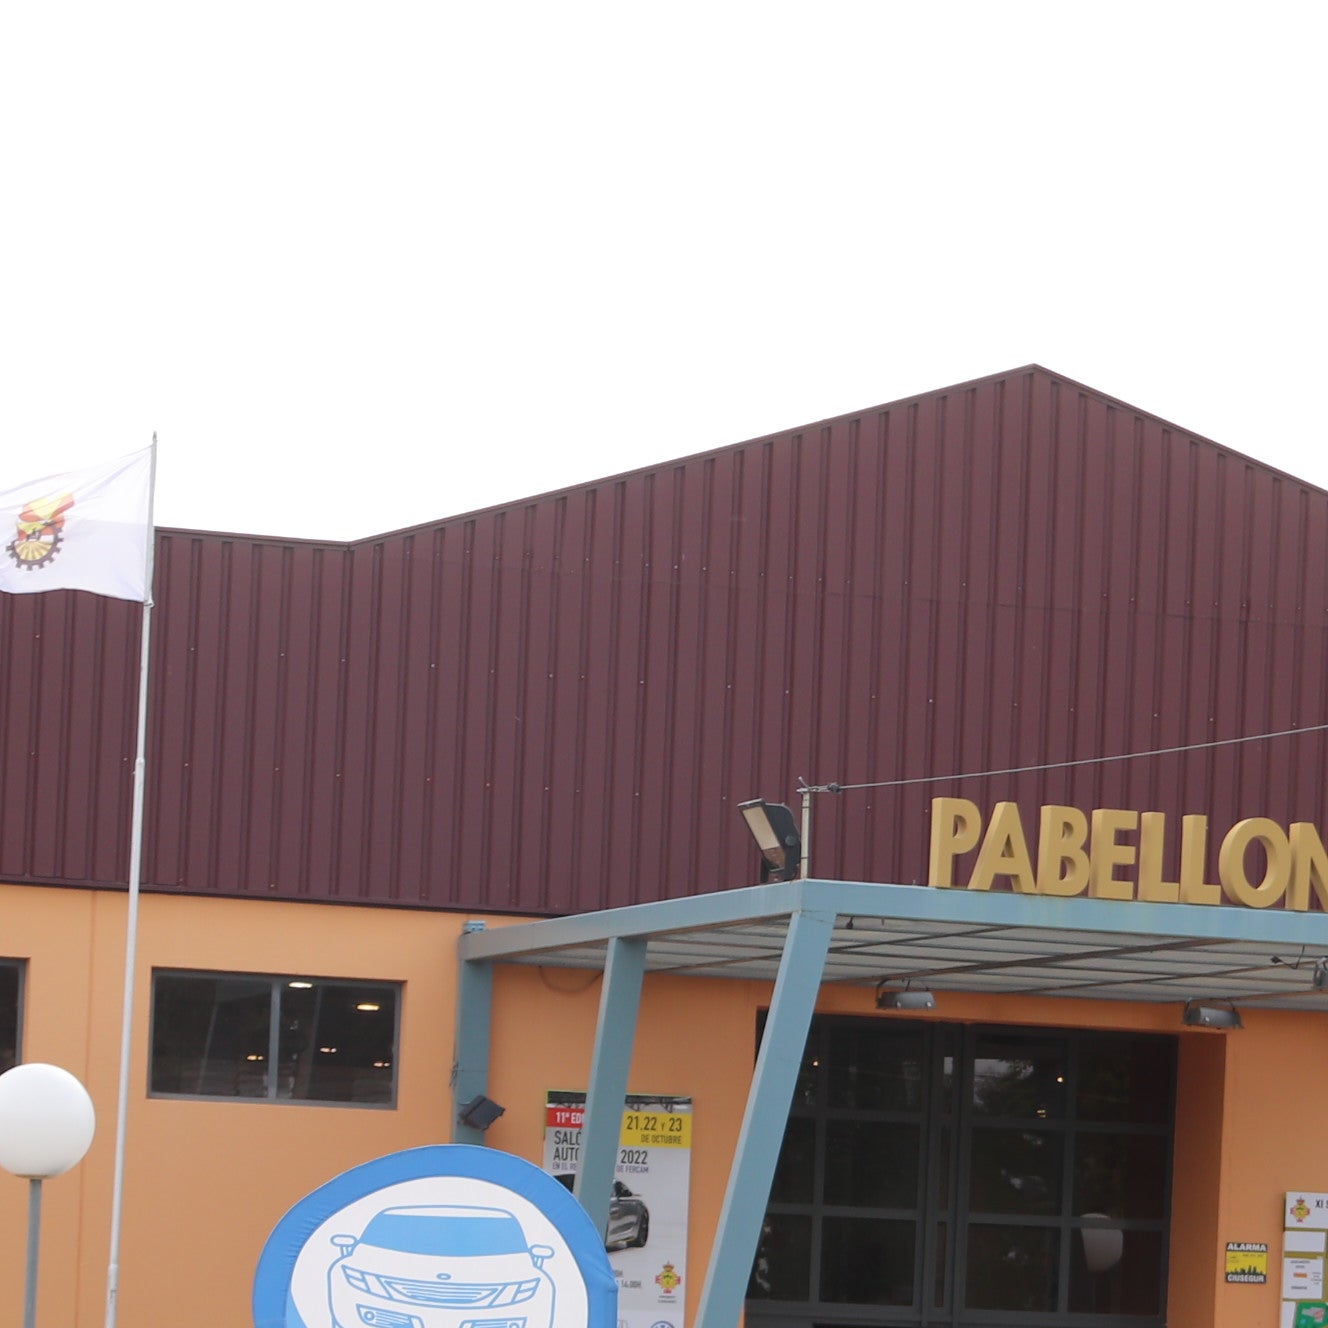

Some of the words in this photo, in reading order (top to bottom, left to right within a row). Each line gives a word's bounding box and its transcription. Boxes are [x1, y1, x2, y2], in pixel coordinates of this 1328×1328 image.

[669, 1117, 682, 1132] 23
[641, 1134, 649, 1143] DE
[651, 1134, 682, 1144] OCTUBRE
[621, 1150, 648, 1165] 2022
[1227, 1243, 1266, 1251] ALARMA
